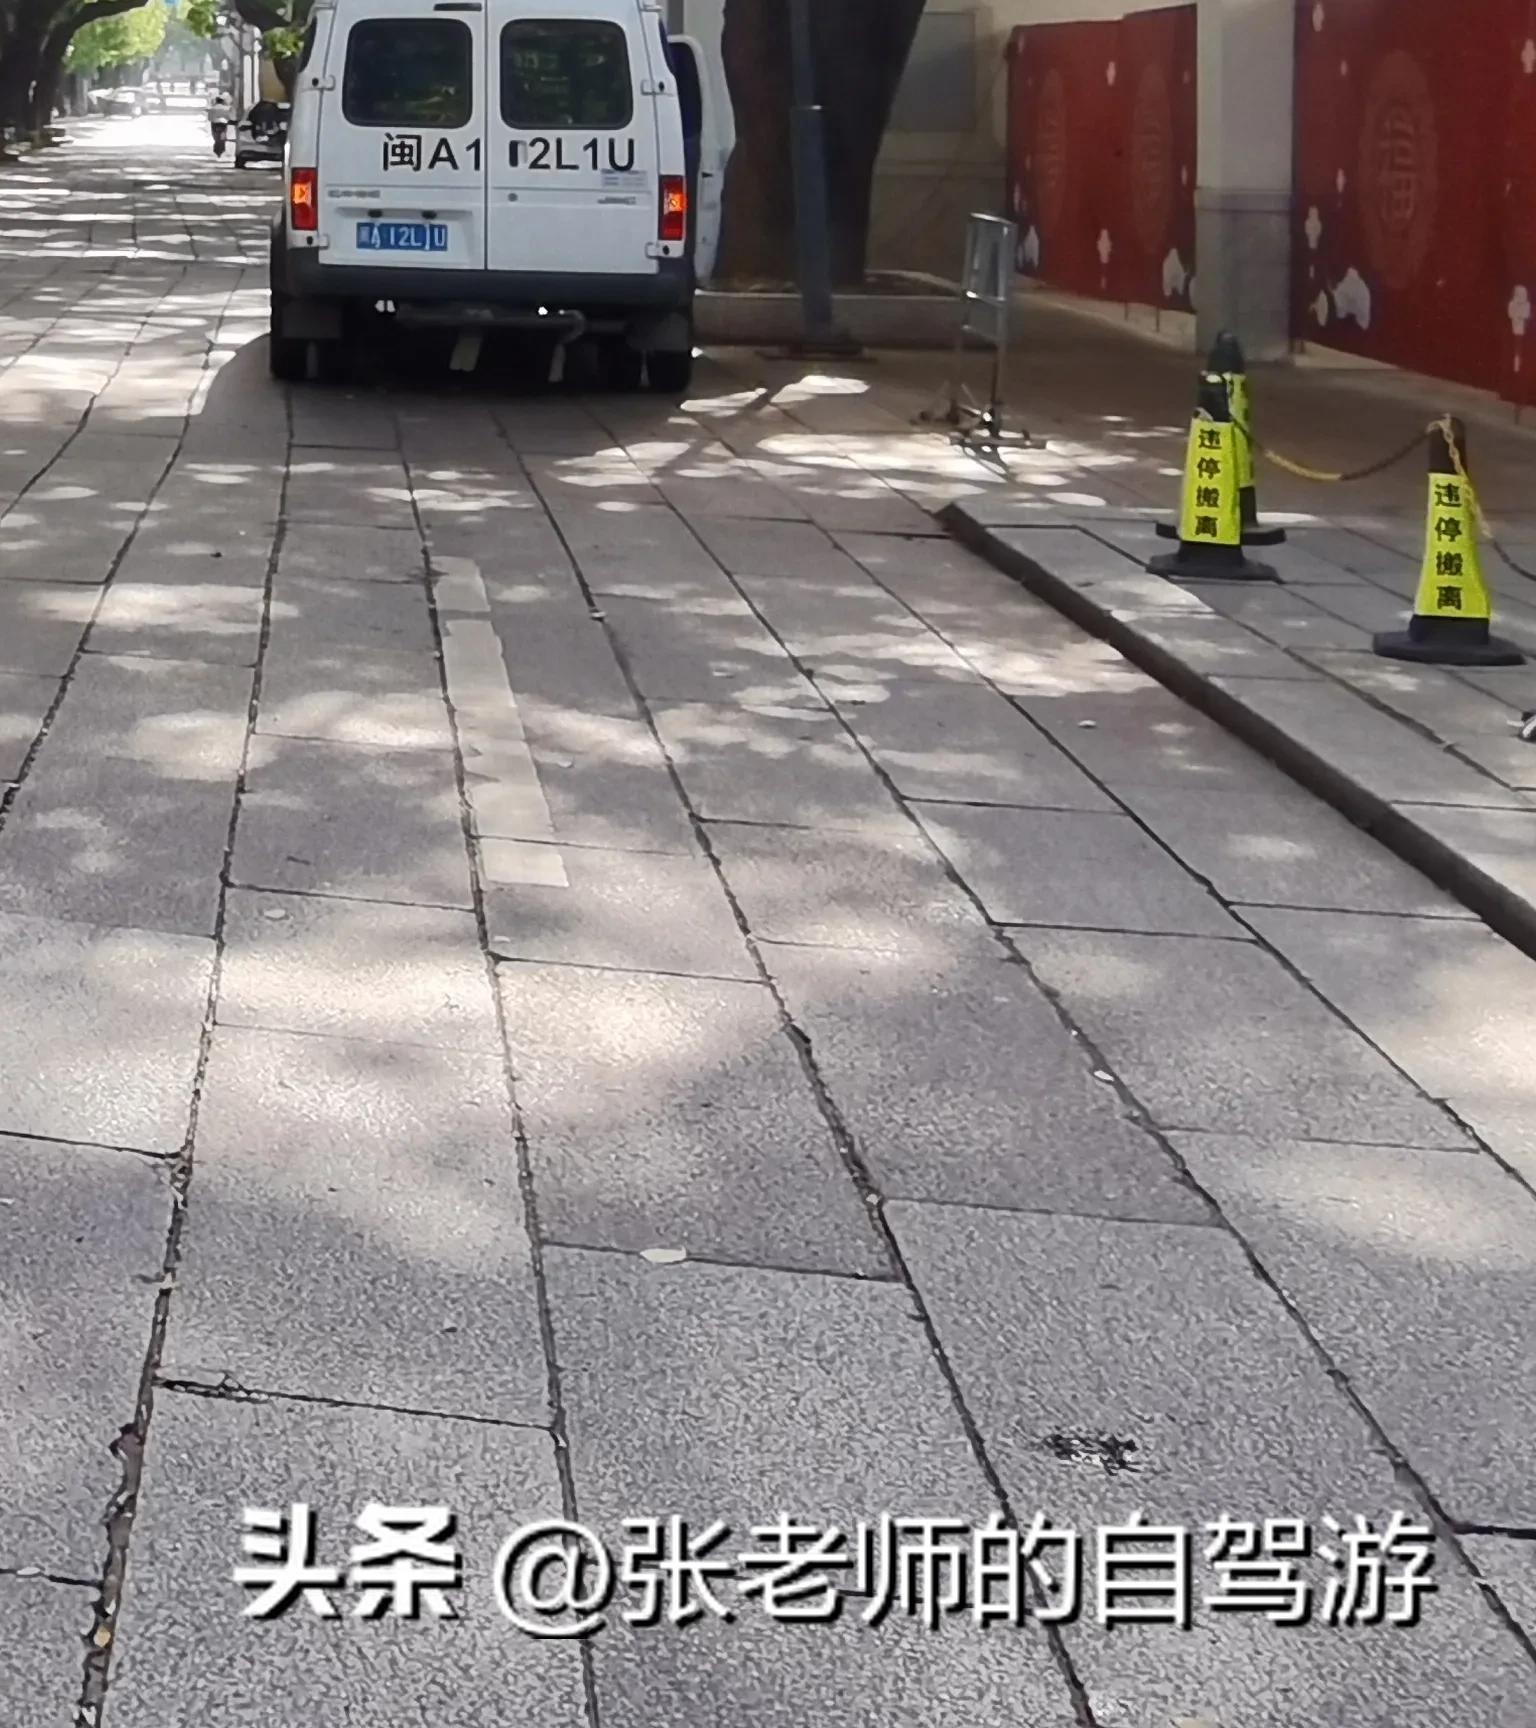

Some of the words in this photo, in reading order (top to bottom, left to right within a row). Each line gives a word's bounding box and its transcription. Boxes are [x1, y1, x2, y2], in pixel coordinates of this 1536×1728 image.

[1194, 428, 1222, 537] 违停搬离
[1435, 483, 1463, 610] 违停搬离
